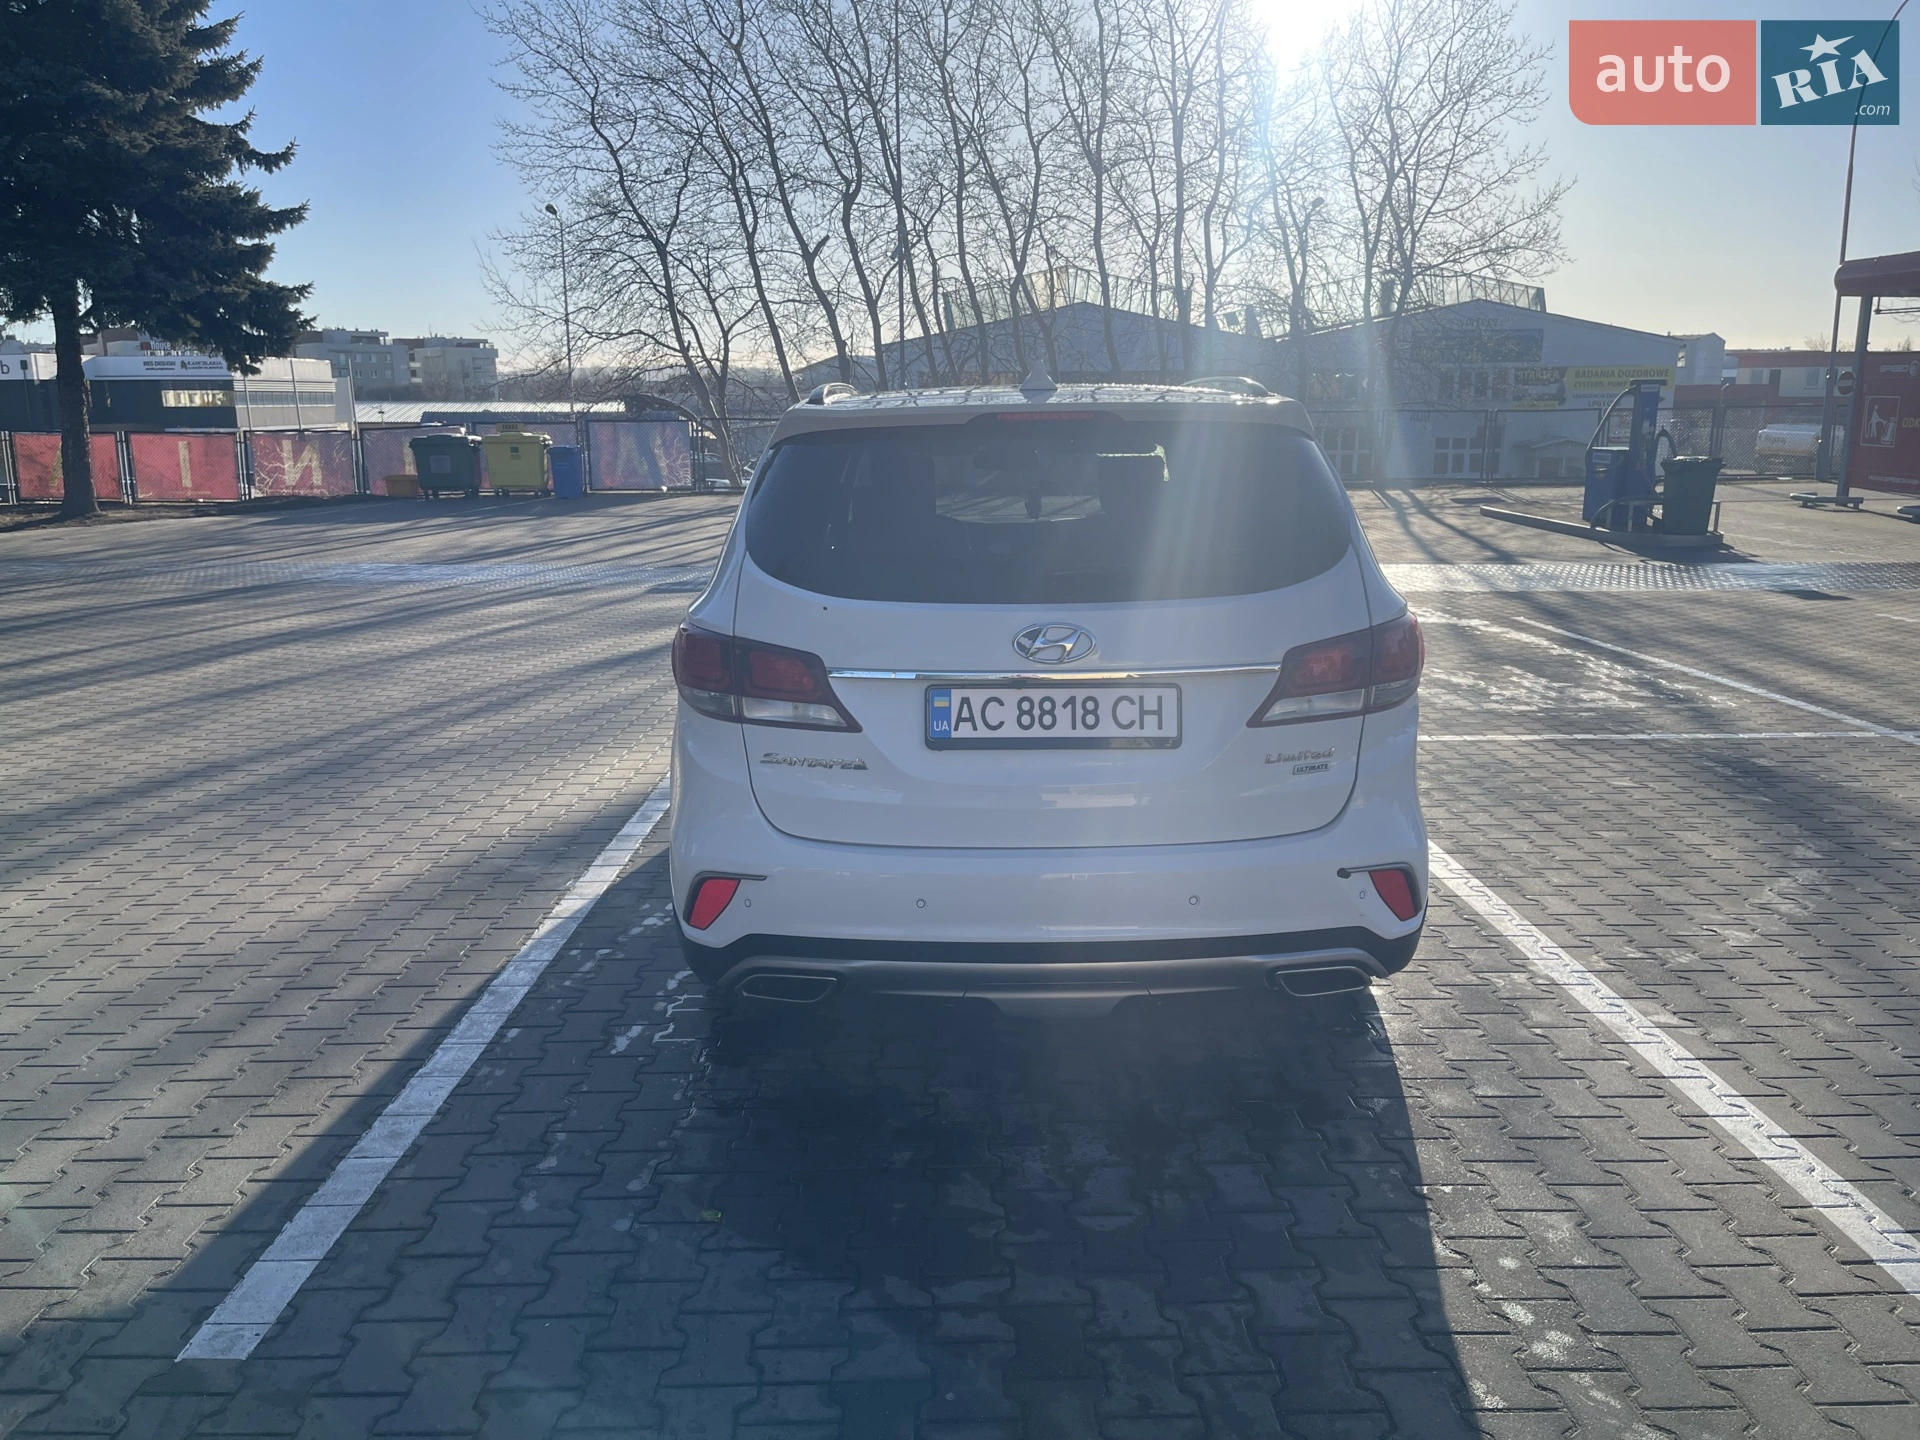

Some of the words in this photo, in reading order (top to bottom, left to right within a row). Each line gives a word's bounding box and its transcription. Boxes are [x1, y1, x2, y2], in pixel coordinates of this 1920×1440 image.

[1574, 369, 1616, 379] BADANIA
[1617, 368, 1670, 378] DOZOROWE
[953, 696, 1005, 732] AC
[1016, 695, 1100, 731] 8818
[1111, 695, 1163, 731] CH
[933, 720, 949, 732] UA
[1296, 764, 1328, 773] ULTIMATE
